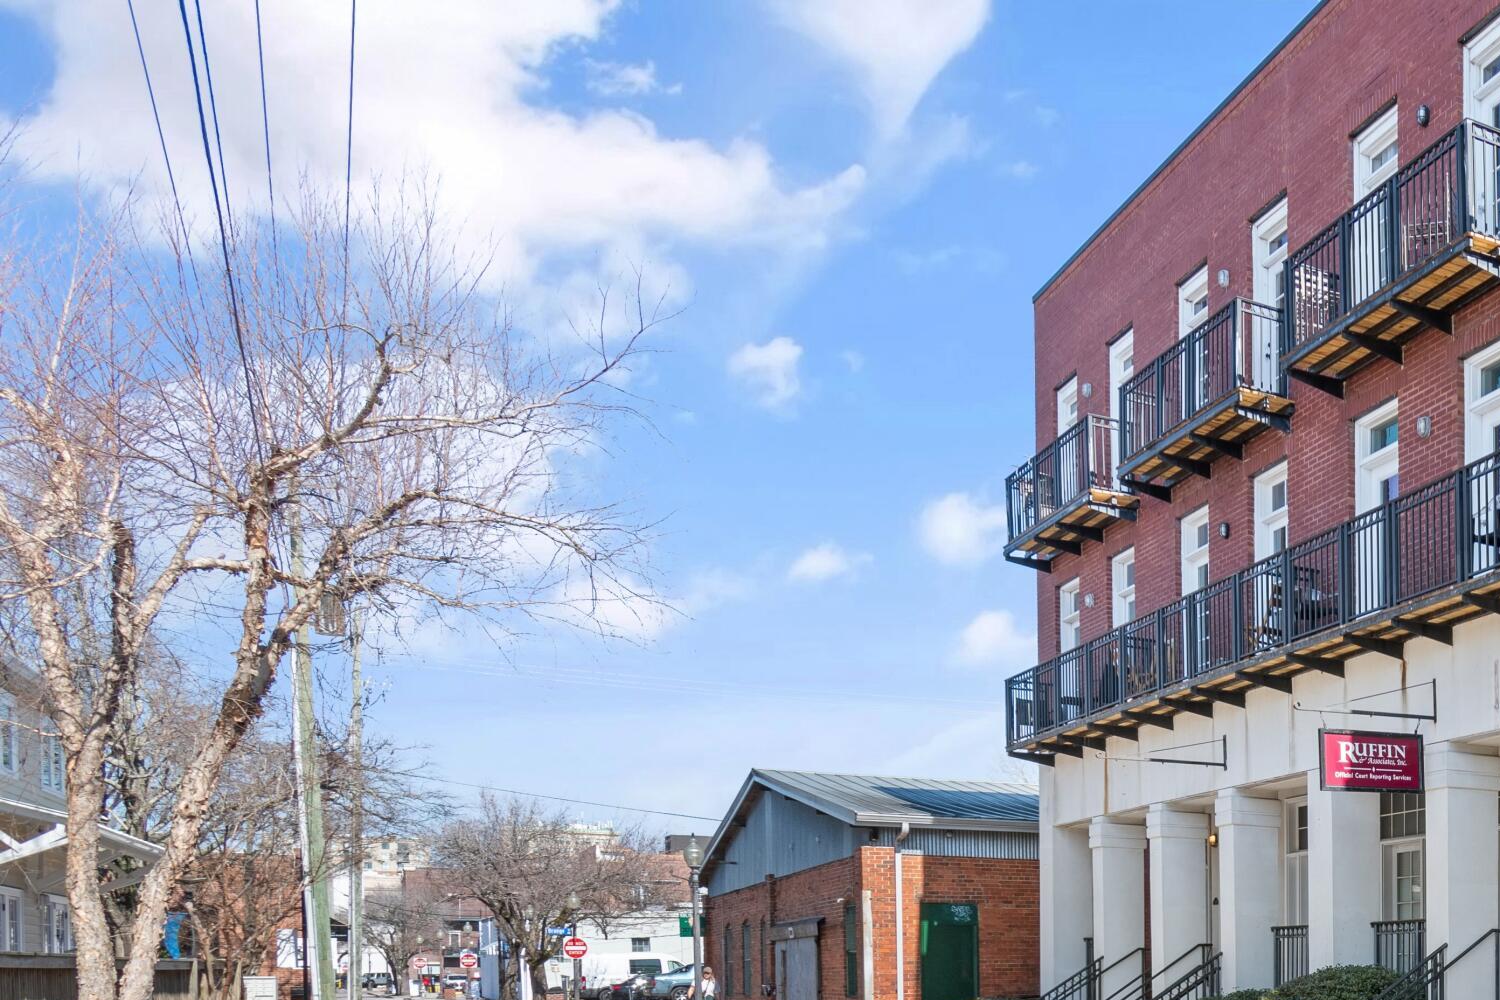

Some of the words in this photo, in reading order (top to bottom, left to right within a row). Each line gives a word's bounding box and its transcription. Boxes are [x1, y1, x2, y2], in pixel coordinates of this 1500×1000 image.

[1336, 741, 1407, 764] RUFFIN
[1367, 757, 1396, 766] Associates,
[1334, 771, 1353, 779] Official
[1369, 773, 1391, 782] Reporting
